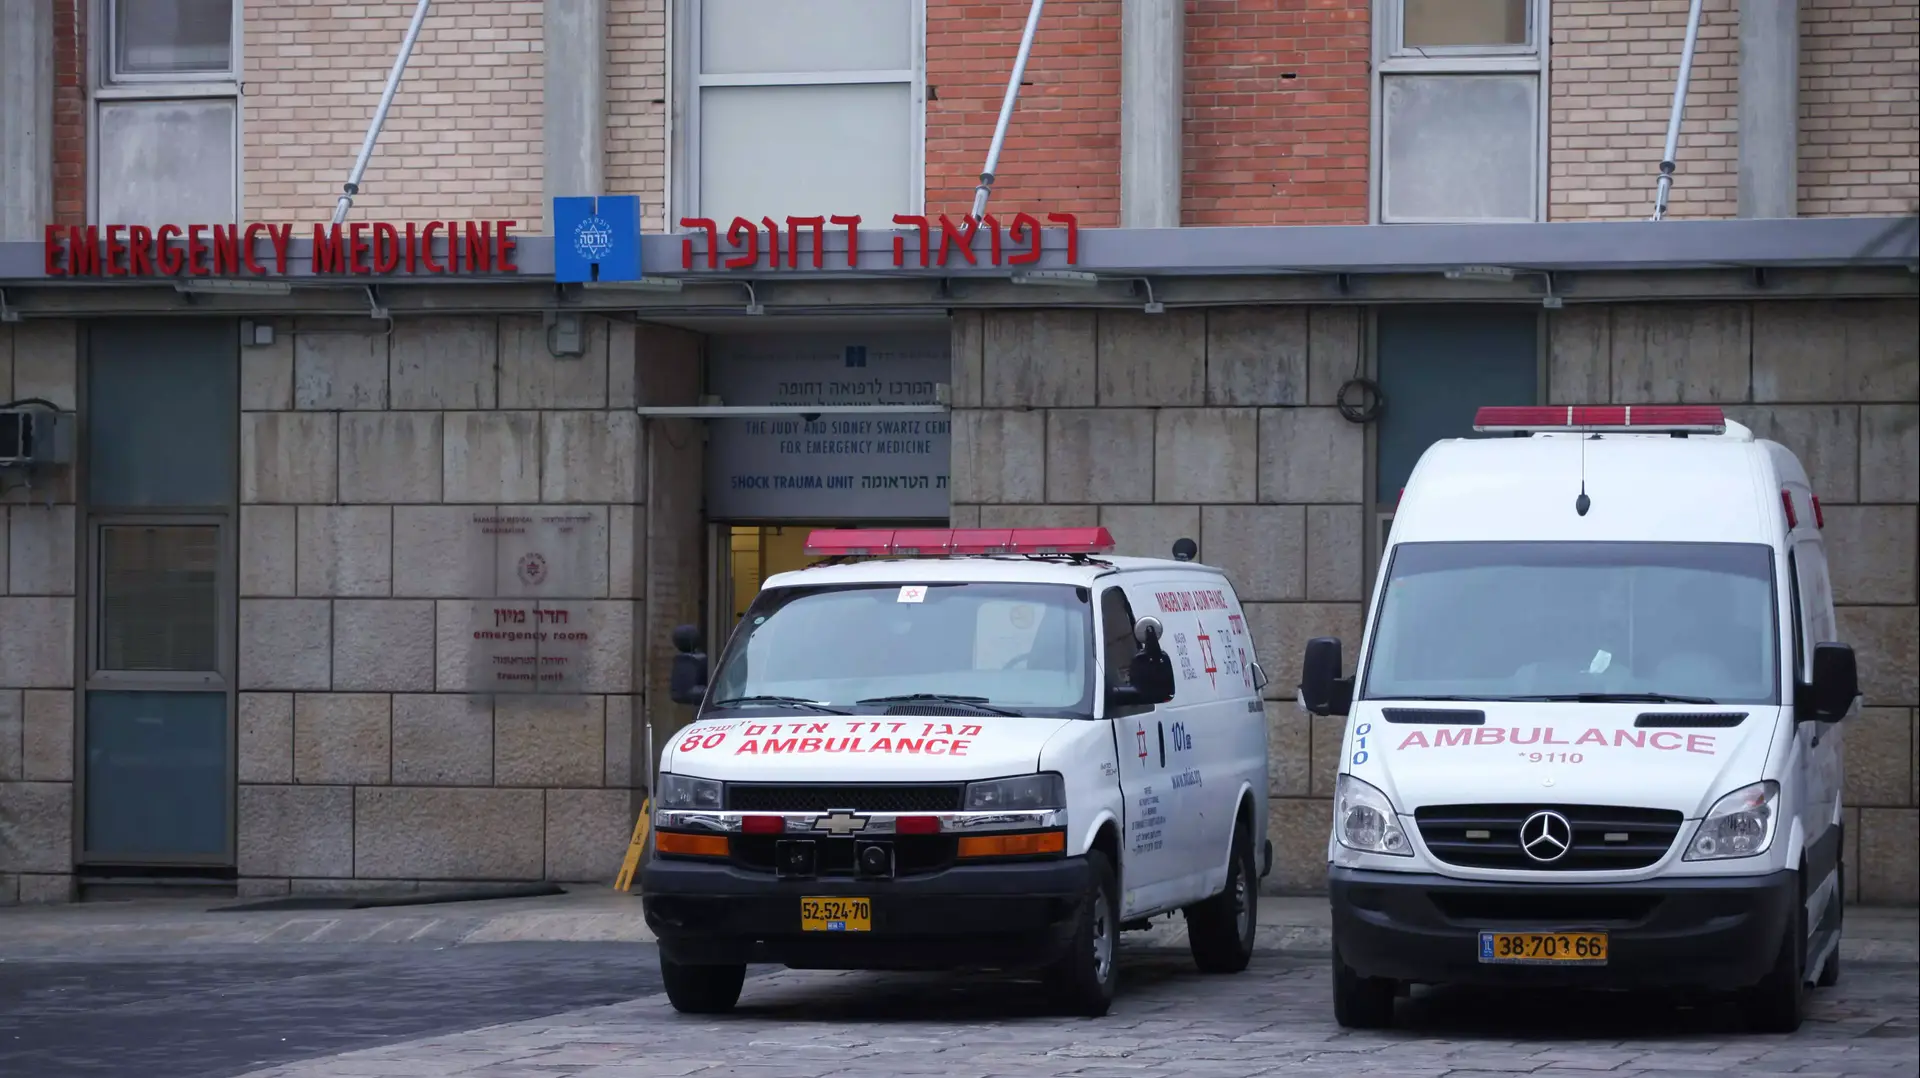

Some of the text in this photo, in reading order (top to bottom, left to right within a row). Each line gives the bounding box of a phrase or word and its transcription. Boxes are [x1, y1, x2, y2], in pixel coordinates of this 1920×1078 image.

[580, 234, 608, 244] הדסה
[680, 211, 1077, 269] רפואה דחופה
[44, 223, 293, 276] EMERGENCY
[312, 220, 518, 274] MEDICINE
[778, 378, 933, 396] המרכז לרפואה דחופה
[746, 421, 766, 435] THE
[770, 421, 800, 435] JUDY
[804, 421, 827, 435] AND
[832, 421, 872, 435] SIDNEY
[877, 420, 919, 434] SWARTZ
[780, 440, 931, 454] FOR EMERGENCY MEDICINE
[731, 475, 854, 489] SHOCK TRAUMA UNIT
[861, 475, 929, 489] הטראומה
[493, 608, 568, 627] חדר מיון
[473, 630, 588, 642] emergency room
[497, 672, 564, 681] trauma unit
[744, 722, 983, 737] מגן דוד אדום
[1171, 721, 1186, 752] 101
[679, 733, 726, 752] 80
[734, 737, 972, 756] AMBULANCE
[1396, 727, 1716, 755] AMBULANCE
